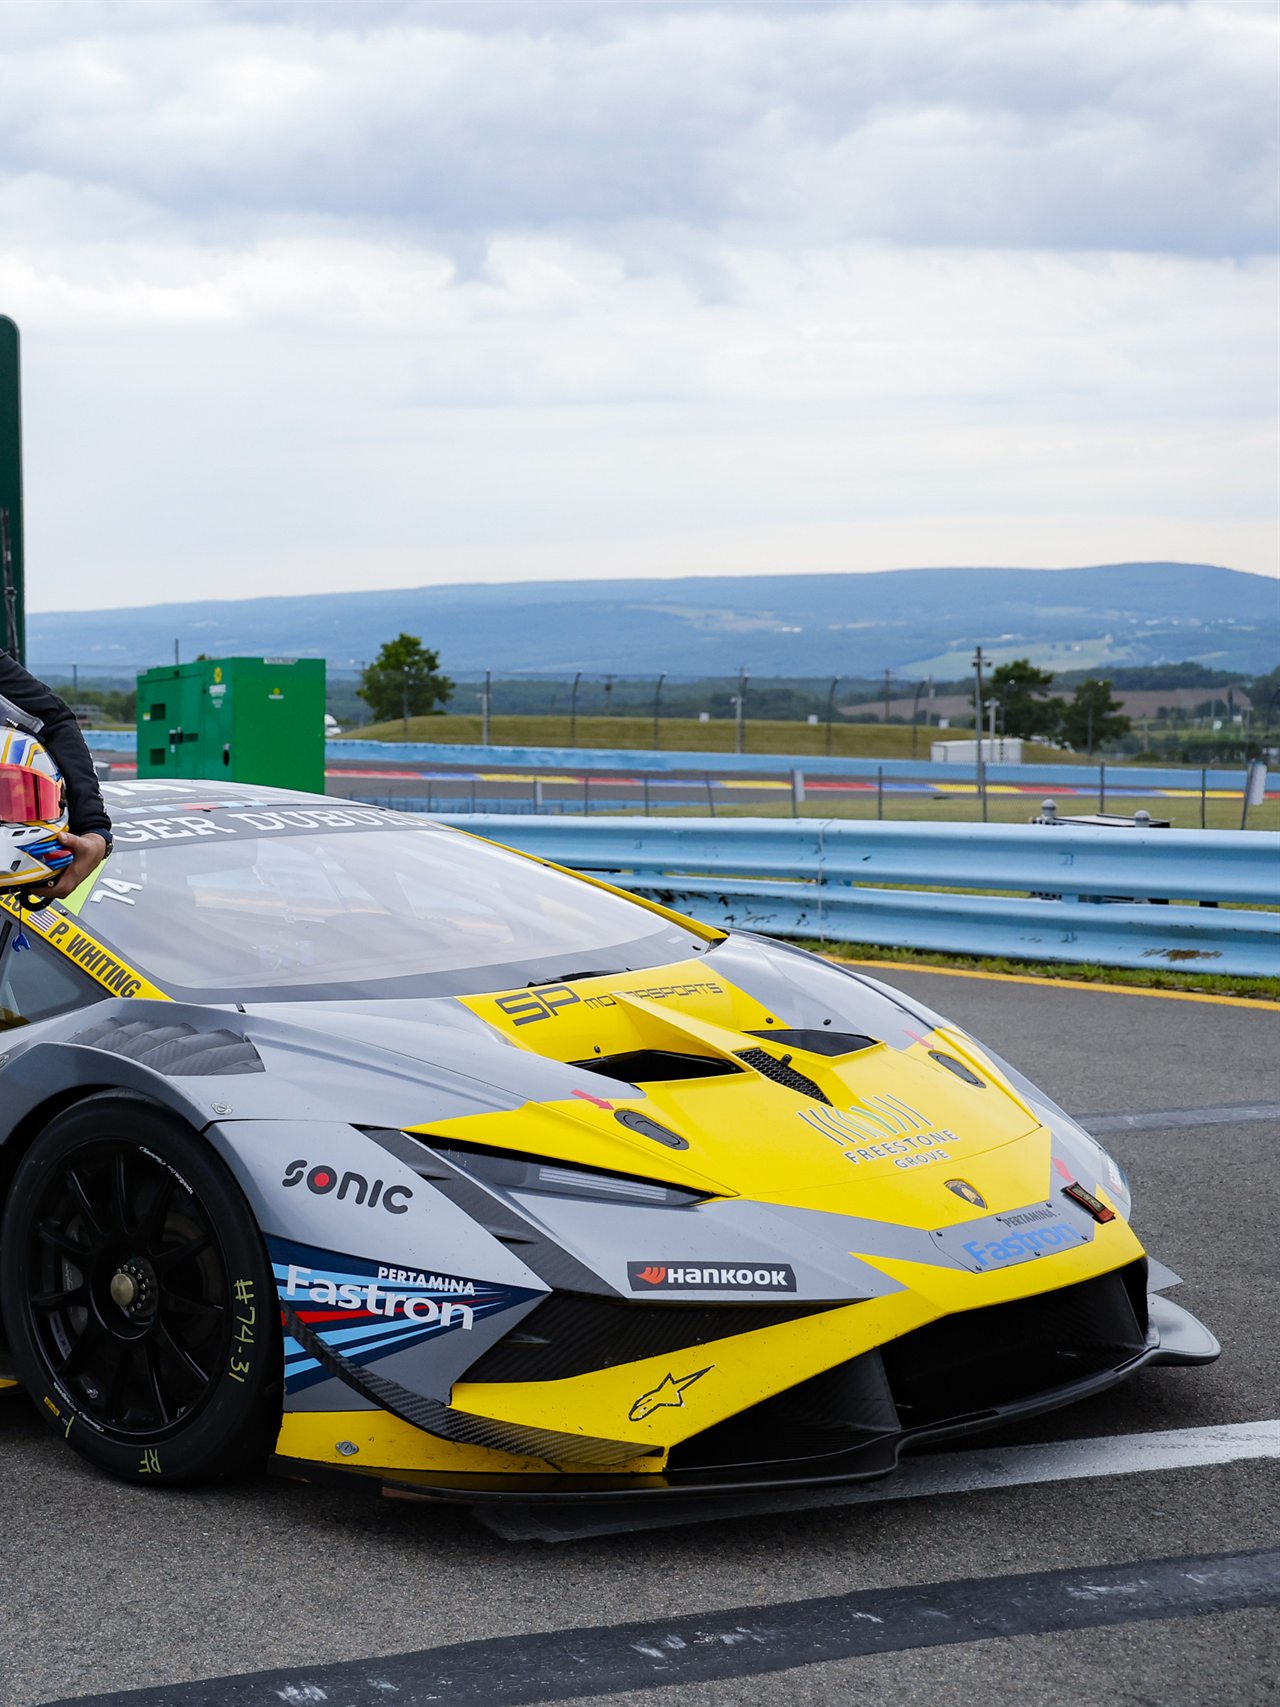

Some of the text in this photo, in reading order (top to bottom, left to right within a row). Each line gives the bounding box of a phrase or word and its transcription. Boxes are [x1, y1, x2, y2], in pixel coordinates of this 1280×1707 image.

[90, 878, 143, 906] 74
[48, 921, 142, 998] P. WHITING
[495, 985, 581, 1027] SP
[844, 1129, 959, 1164] FREESTONE
[894, 1149, 950, 1169] GROVE
[1003, 1208, 1057, 1227] PERTAMINA
[962, 1220, 1078, 1266] Fastron
[286, 1264, 474, 1330] Fastron
[377, 1266, 476, 1296] PERTAMINA
